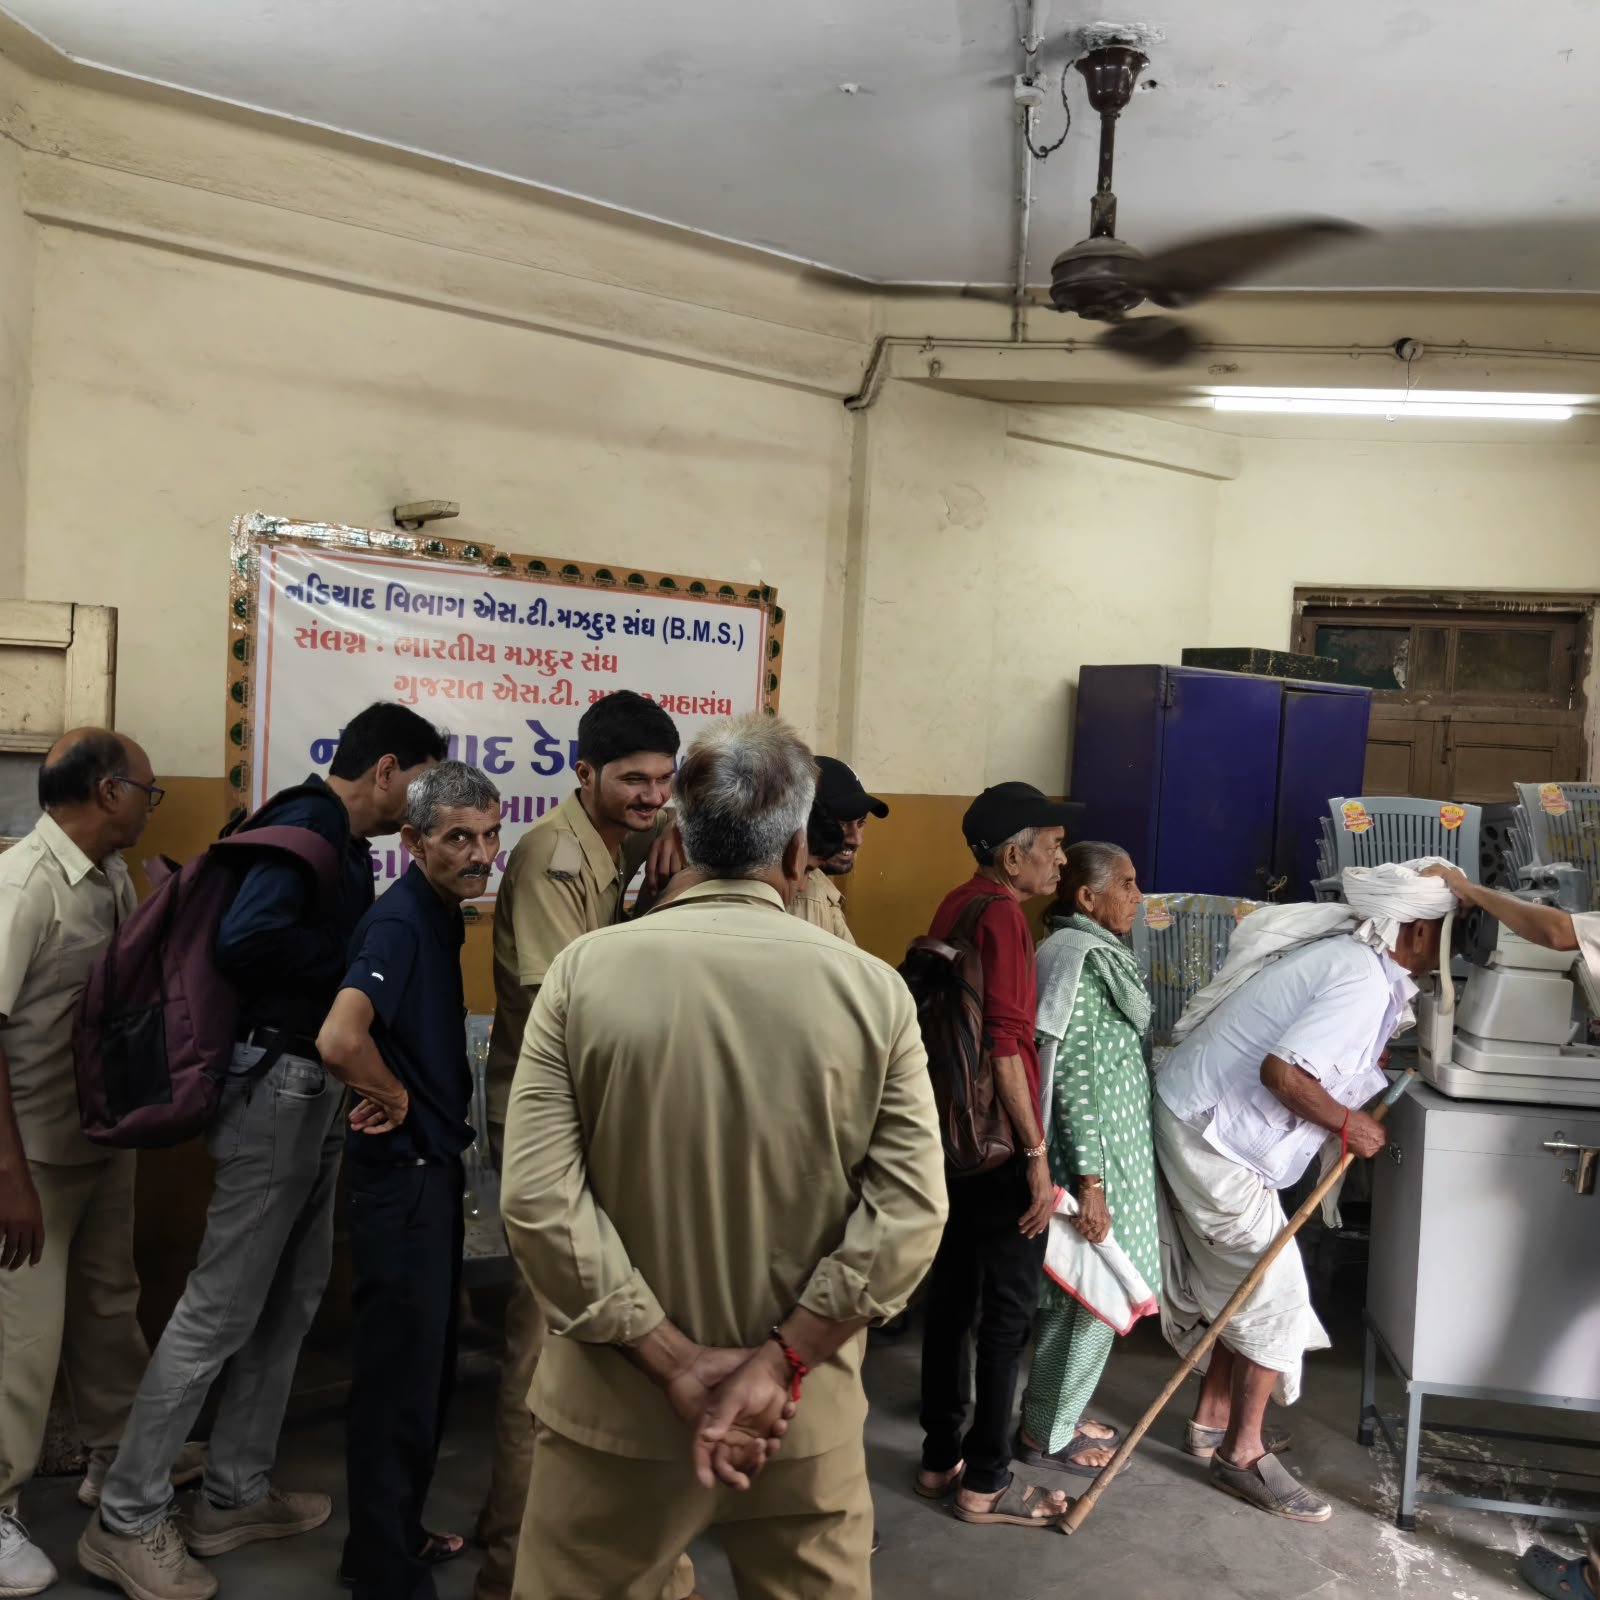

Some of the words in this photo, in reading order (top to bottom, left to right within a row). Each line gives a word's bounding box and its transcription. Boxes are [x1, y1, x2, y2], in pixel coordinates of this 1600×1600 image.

[284, 572, 376, 610] નડિયાદ
[384, 581, 465, 618] વિભાગ
[622, 608, 656, 637] સંઘ
[662, 615, 744, 652] (B.M.S.)
[294, 619, 366, 654] સંલગ્ન
[393, 633, 496, 664] ભારતીય
[504, 645, 574, 677] મઝદુર
[580, 645, 618, 673] સંઘ
[393, 674, 484, 705] ગુજરાત
[492, 674, 580, 707] એસ.ટી.
[659, 689, 732, 716] મહાસંઘ
